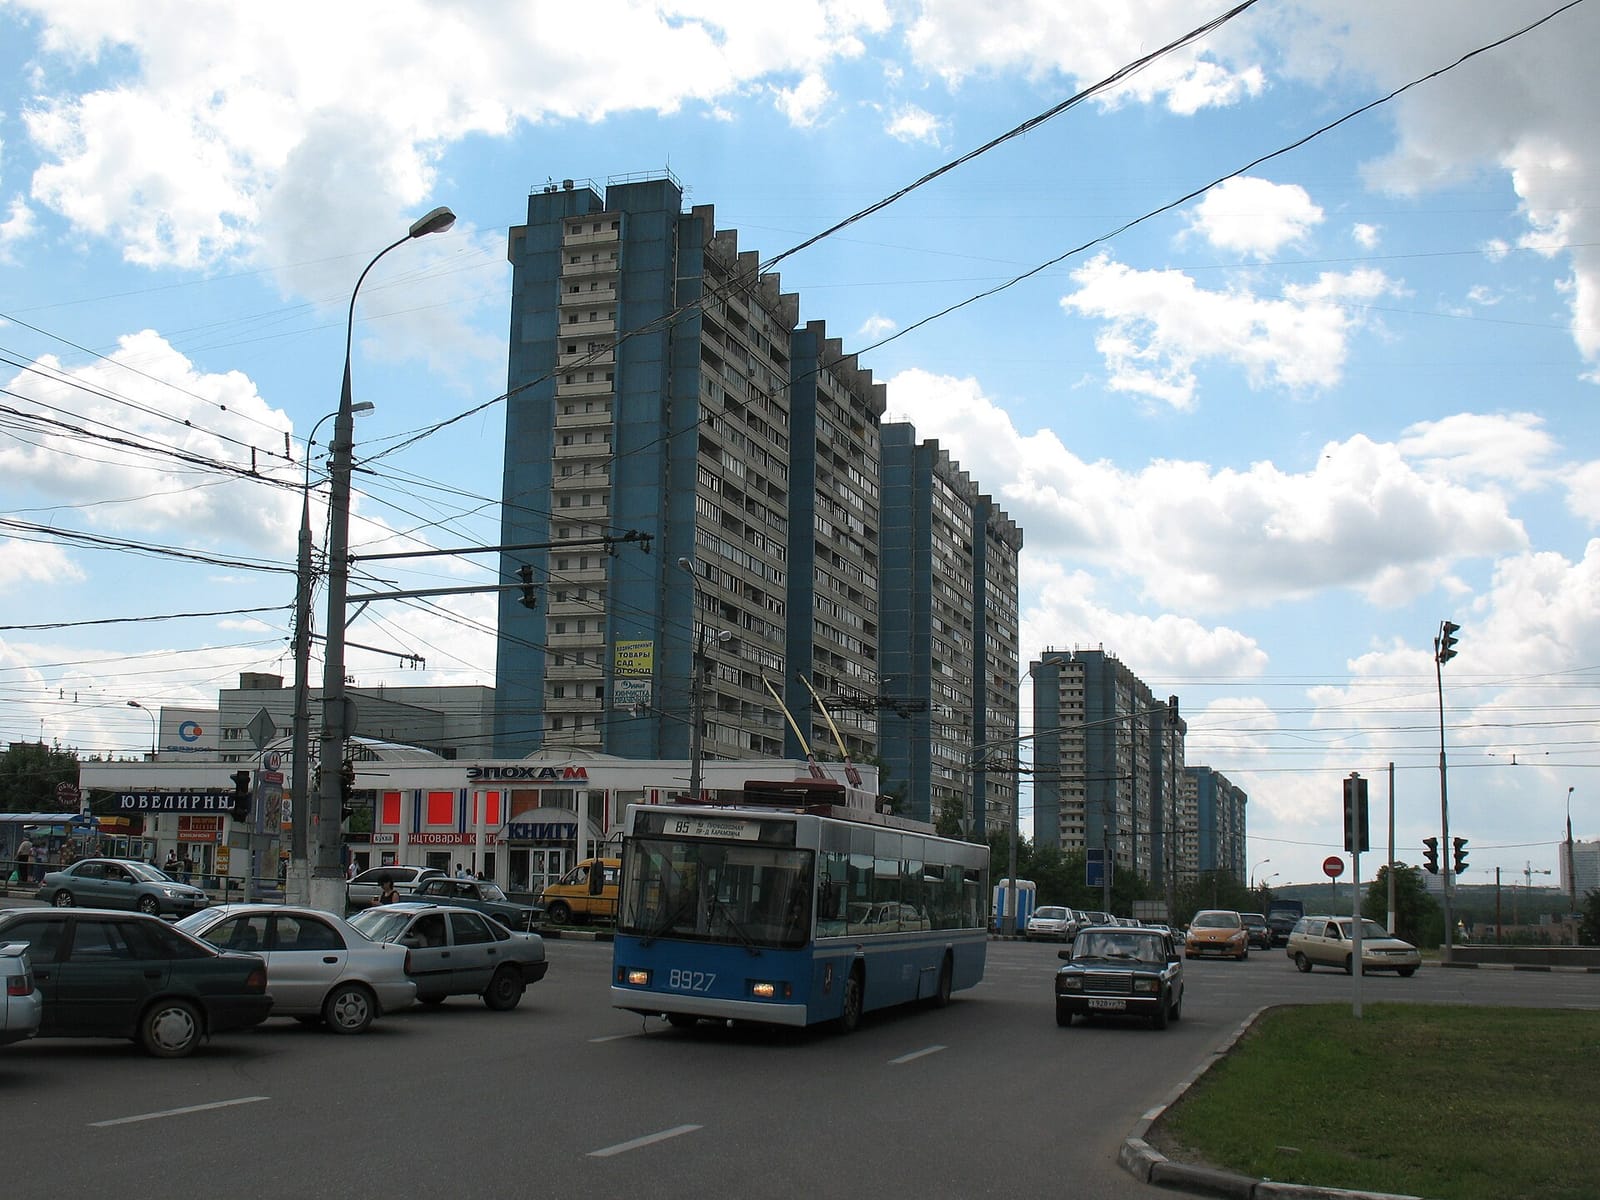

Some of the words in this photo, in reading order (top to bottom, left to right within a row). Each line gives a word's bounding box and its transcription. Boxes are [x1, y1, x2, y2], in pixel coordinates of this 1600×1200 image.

[466, 766, 589, 780] ЭПОХА-М
[508, 822, 579, 840] КНИГИ
[675, 821, 690, 834] 85
[407, 834, 463, 844] нцтовары
[670, 969, 717, 991] 8927
